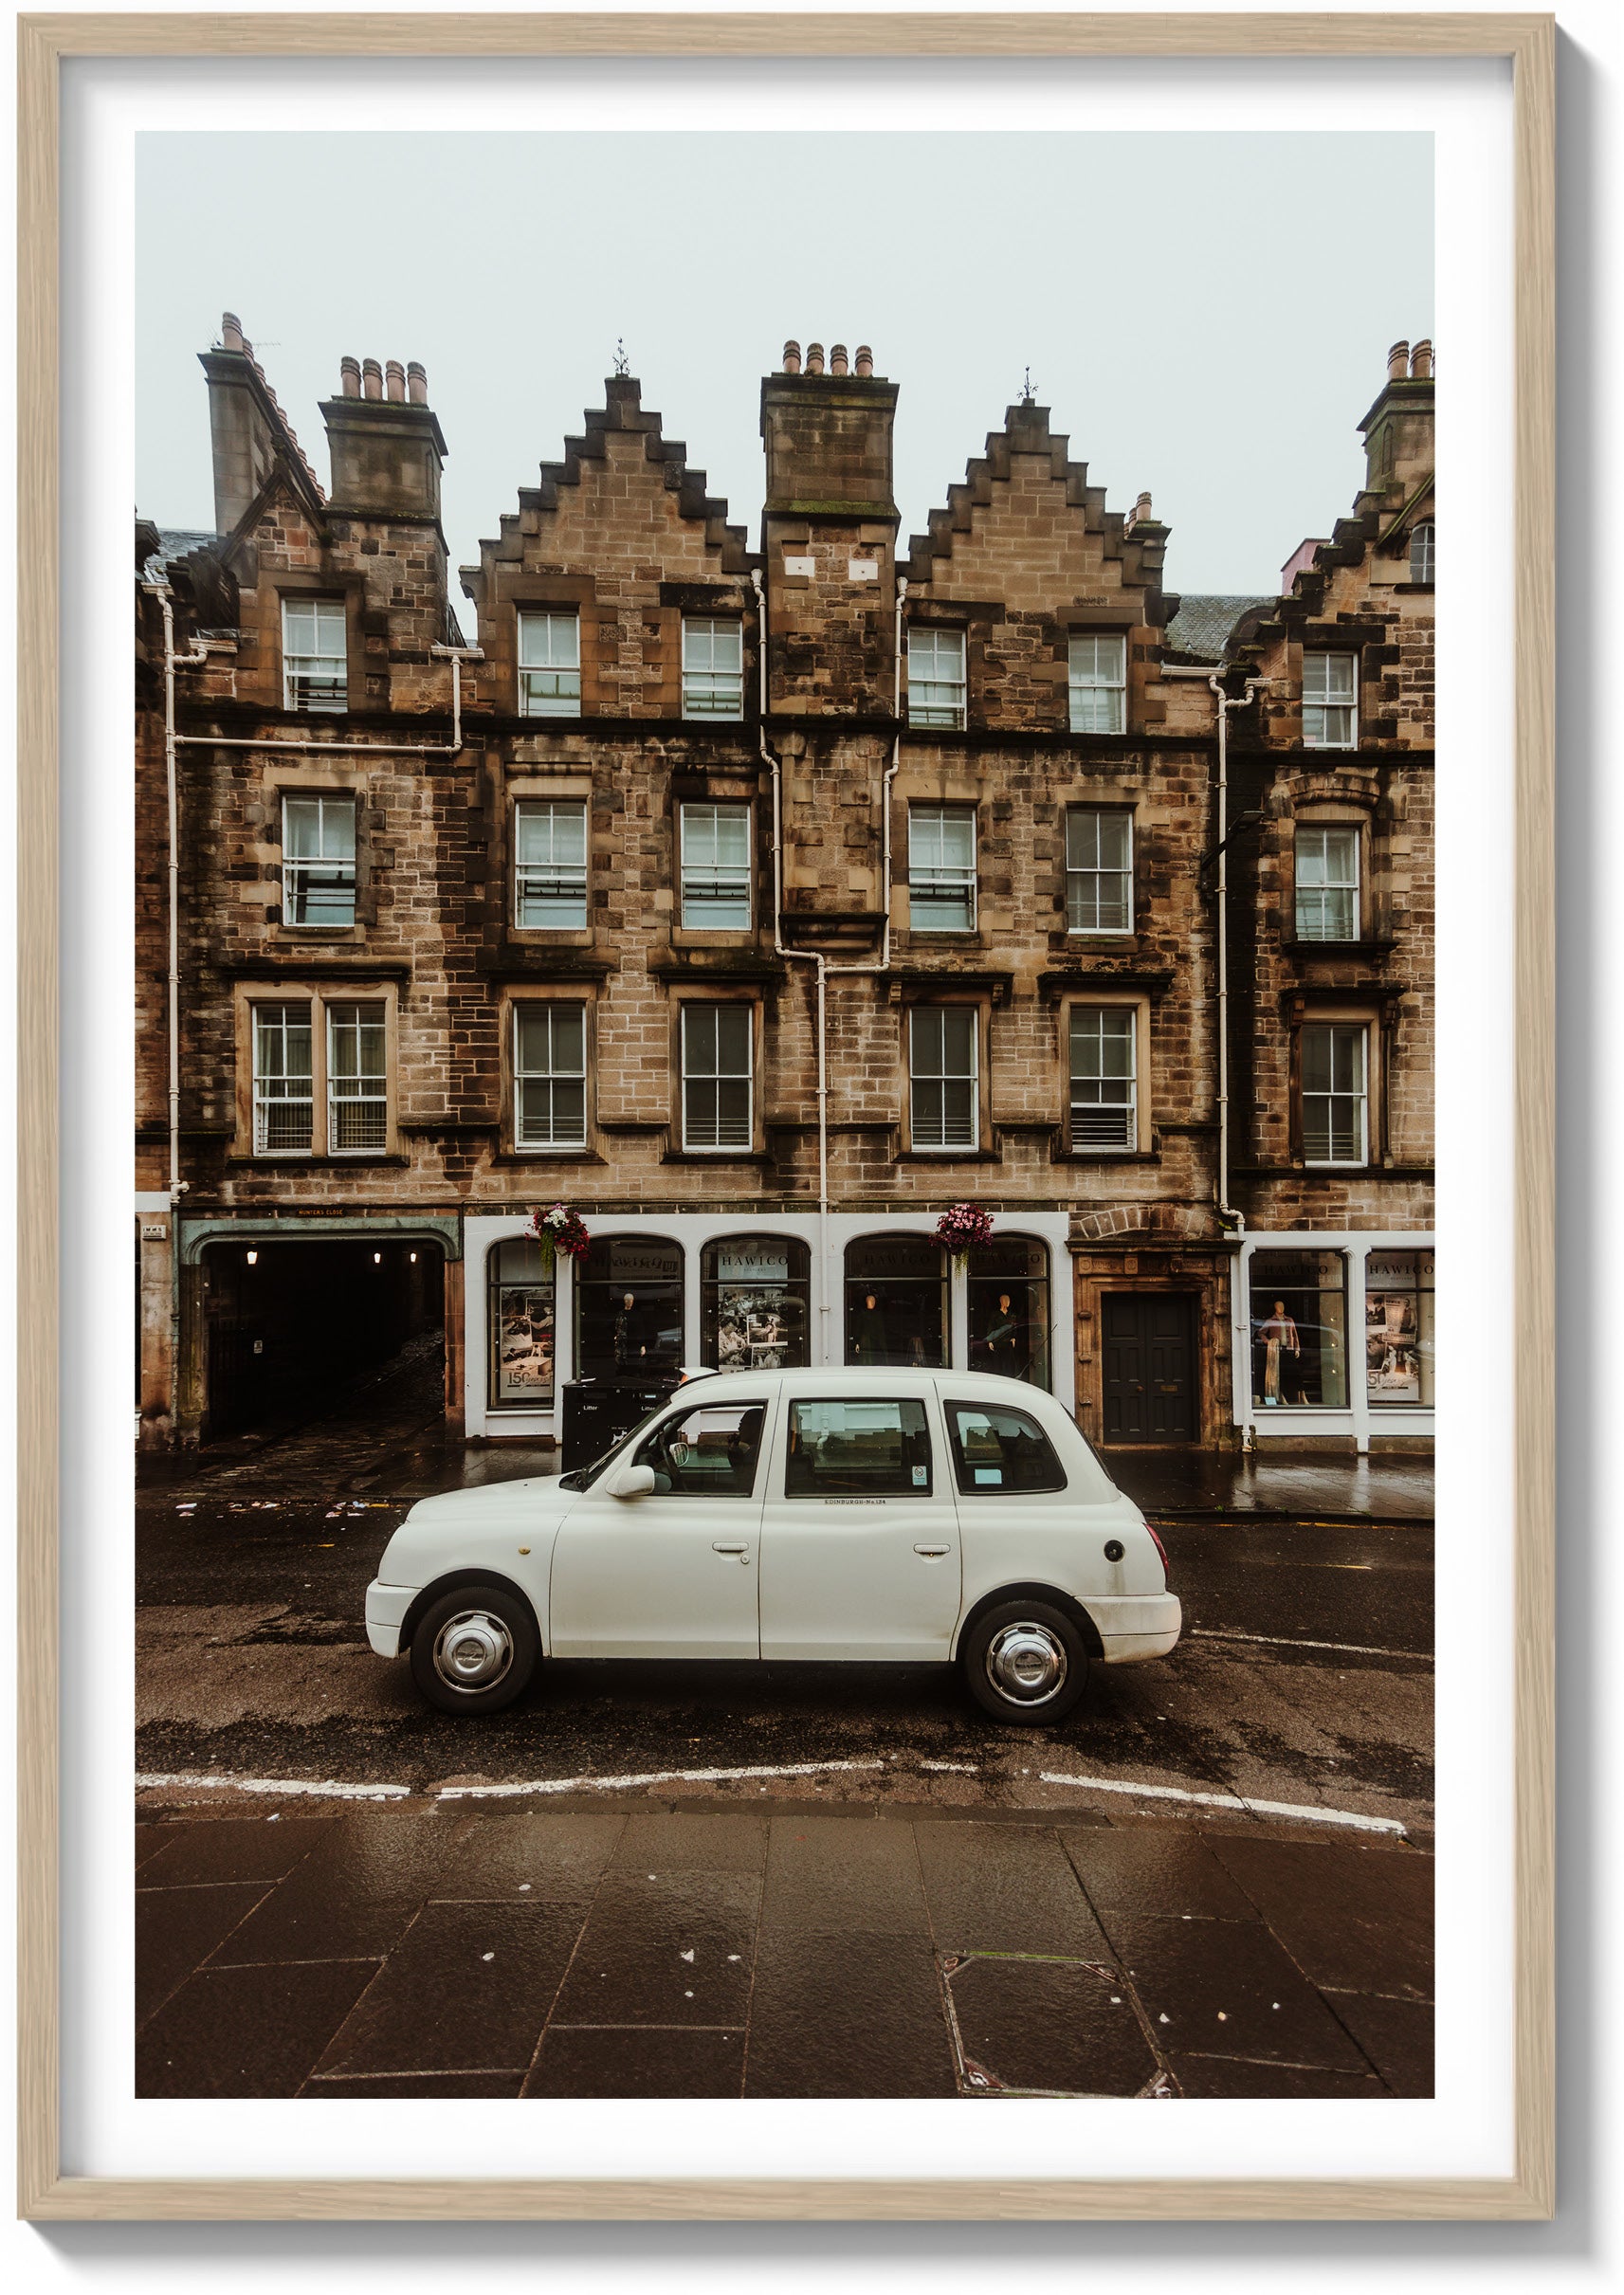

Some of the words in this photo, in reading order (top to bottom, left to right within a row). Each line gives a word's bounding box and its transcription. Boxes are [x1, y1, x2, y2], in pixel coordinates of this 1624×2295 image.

[722, 1256, 789, 1266] HAWICO
[865, 1254, 930, 1265] HAWICO
[1264, 1266, 1328, 1275] HAWICO
[1369, 1265, 1433, 1275] HAWICO
[508, 1372, 530, 1384] 150
